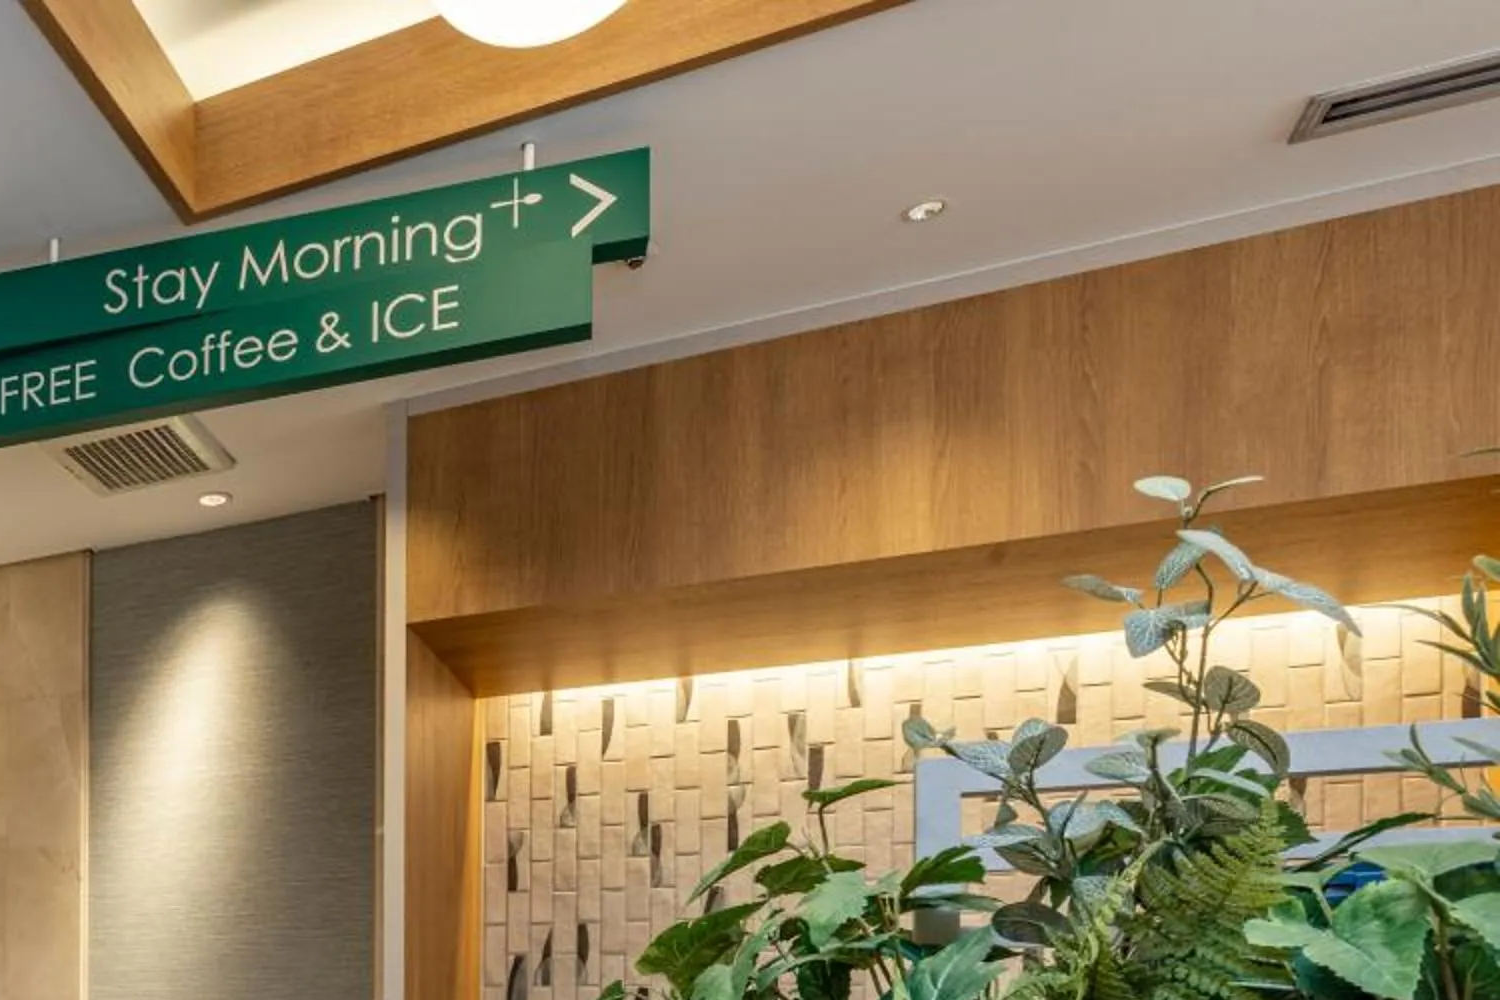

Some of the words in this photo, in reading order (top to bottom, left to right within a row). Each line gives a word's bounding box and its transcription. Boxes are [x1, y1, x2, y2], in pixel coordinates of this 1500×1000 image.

[104, 259, 221, 315] Stay
[237, 212, 484, 291] Morning
[0, 358, 98, 416] FREE
[128, 325, 299, 390] Coffee
[315, 311, 352, 353] &
[370, 284, 460, 344] ICE
